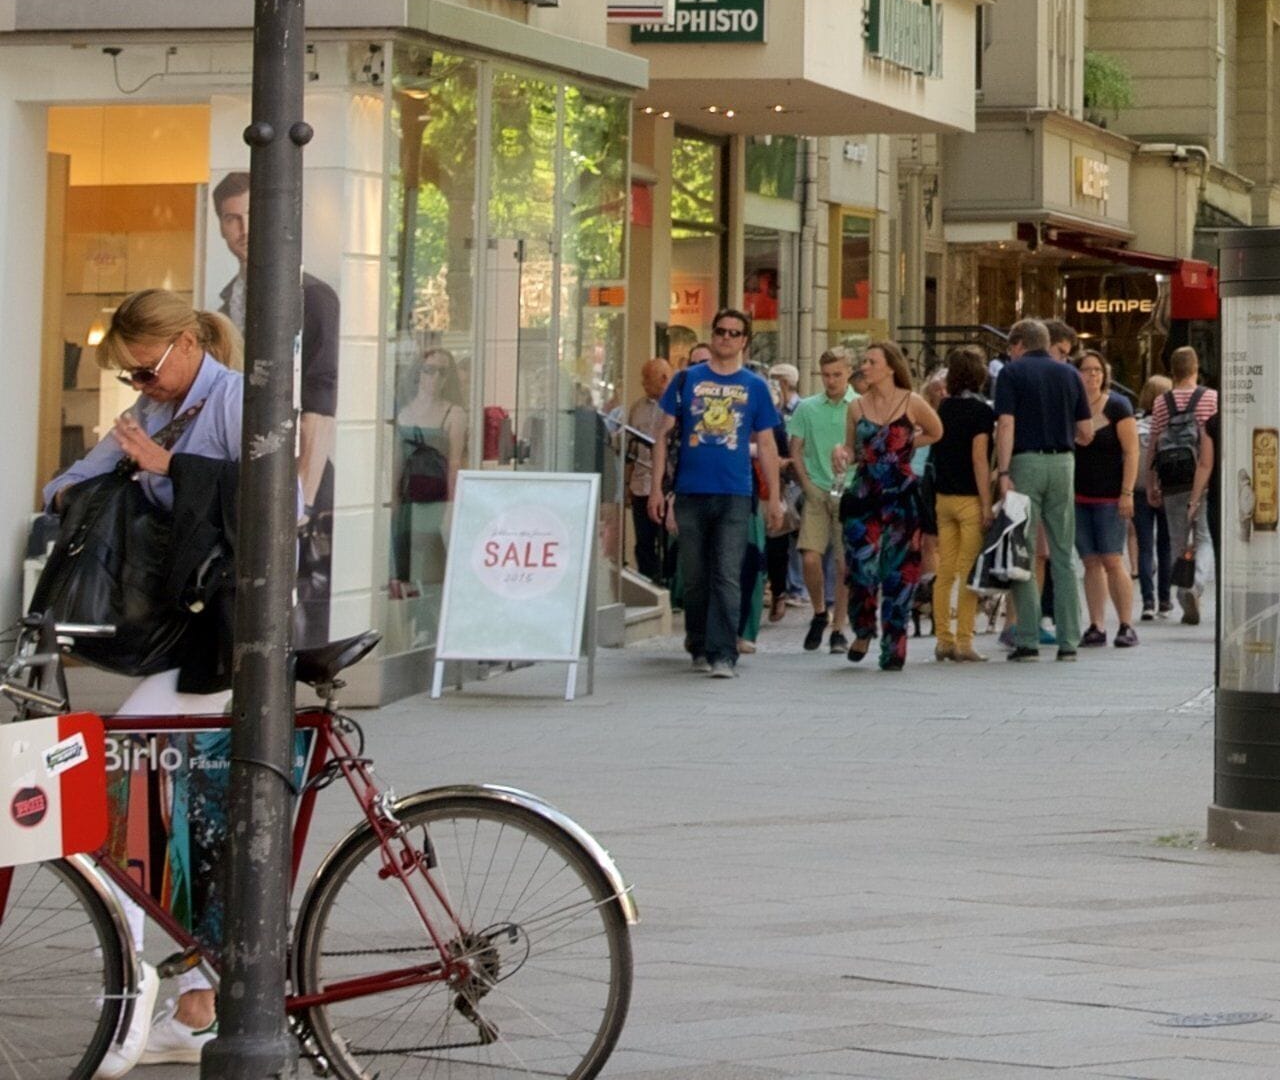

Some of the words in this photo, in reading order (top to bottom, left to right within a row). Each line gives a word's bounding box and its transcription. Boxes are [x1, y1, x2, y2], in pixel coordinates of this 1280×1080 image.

[1076, 299, 1152, 313] WEMPE
[484, 541, 559, 568] SALE
[104, 738, 182, 771] Birlo
